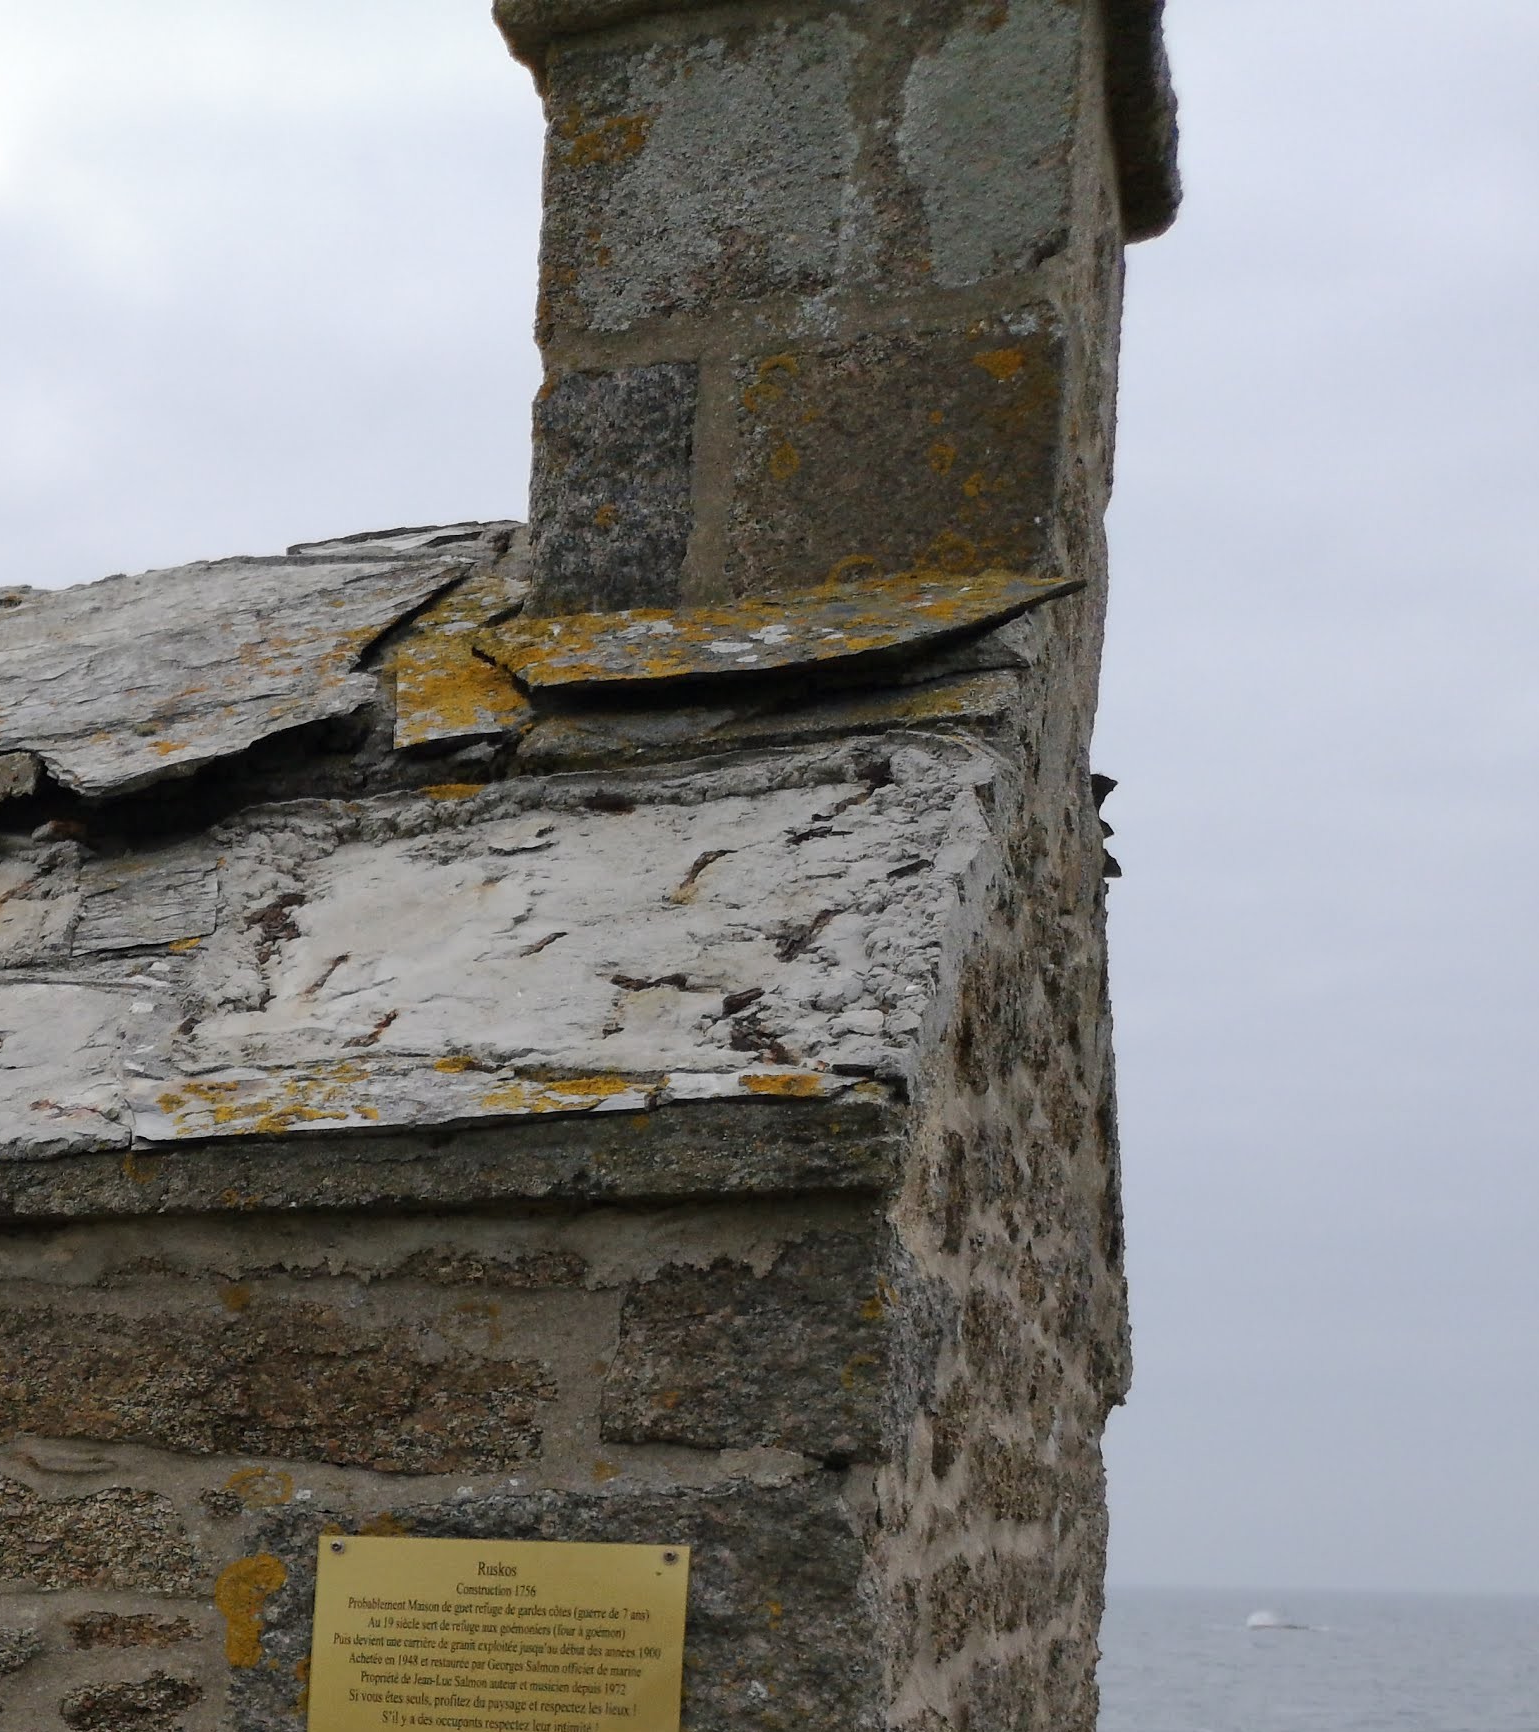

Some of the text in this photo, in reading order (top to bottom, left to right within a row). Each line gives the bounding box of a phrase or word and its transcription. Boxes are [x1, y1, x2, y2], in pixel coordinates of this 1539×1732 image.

[478, 1561, 517, 1577] Ruskos
[456, 1583, 536, 1597] Construction 1756
[348, 1597, 406, 1610] Probablement
[442, 1601, 452, 1612] de
[475, 1602, 502, 1617] refuge
[505, 1603, 515, 1615] de
[518, 1605, 546, 1618] gardes
[574, 1607, 606, 1621] (guerre
[609, 1609, 619, 1619] de
[630, 1609, 650, 1621] ans)
[368, 1617, 381, 1628] Au
[383, 1618, 394, 1628] 19
[396, 1618, 419, 1629] siècle
[422, 1620, 438, 1630] sert
[440, 1620, 450, 1631] de
[452, 1621, 479, 1635] refuge
[553, 1624, 575, 1638] (four
[334, 1633, 351, 1645] Puis
[353, 1634, 384, 1646] devient
[387, 1637, 401, 1647] une
[404, 1637, 435, 1648] carrière
[438, 1638, 448, 1649] de
[451, 1640, 475, 1652] granit
[588, 1645, 602, 1656] des
[349, 1652, 382, 1664] Achetée
[385, 1656, 395, 1665] en
[398, 1655, 418, 1665] 1948
[421, 1656, 429, 1666] et
[471, 1660, 485, 1670] par
[488, 1658, 523, 1674] Georges
[526, 1661, 559, 1673] Salmon
[597, 1664, 608, 1675] de
[361, 1671, 399, 1686] Propriété
[401, 1673, 411, 1684] de
[414, 1674, 452, 1686] Jean-Luc
[454, 1676, 487, 1688] Salmon
[490, 1678, 517, 1690] auteur
[520, 1681, 527, 1690] et
[572, 1683, 601, 1696] depuis
[604, 1683, 626, 1695] 1972
[349, 1688, 360, 1702] Si
[362, 1692, 383, 1703] vous
[434, 1694, 470, 1707] profitez
[473, 1696, 485, 1707] du
[488, 1699, 526, 1713] paysage
[528, 1701, 538, 1711] et
[540, 1702, 585, 1715] respectez
[588, 1703, 602, 1714] les
[418, 1714, 433, 1726] des
[436, 1717, 482, 1730] occupants
[485, 1719, 530, 1732] respectez
[533, 1720, 550, 1732] leur
